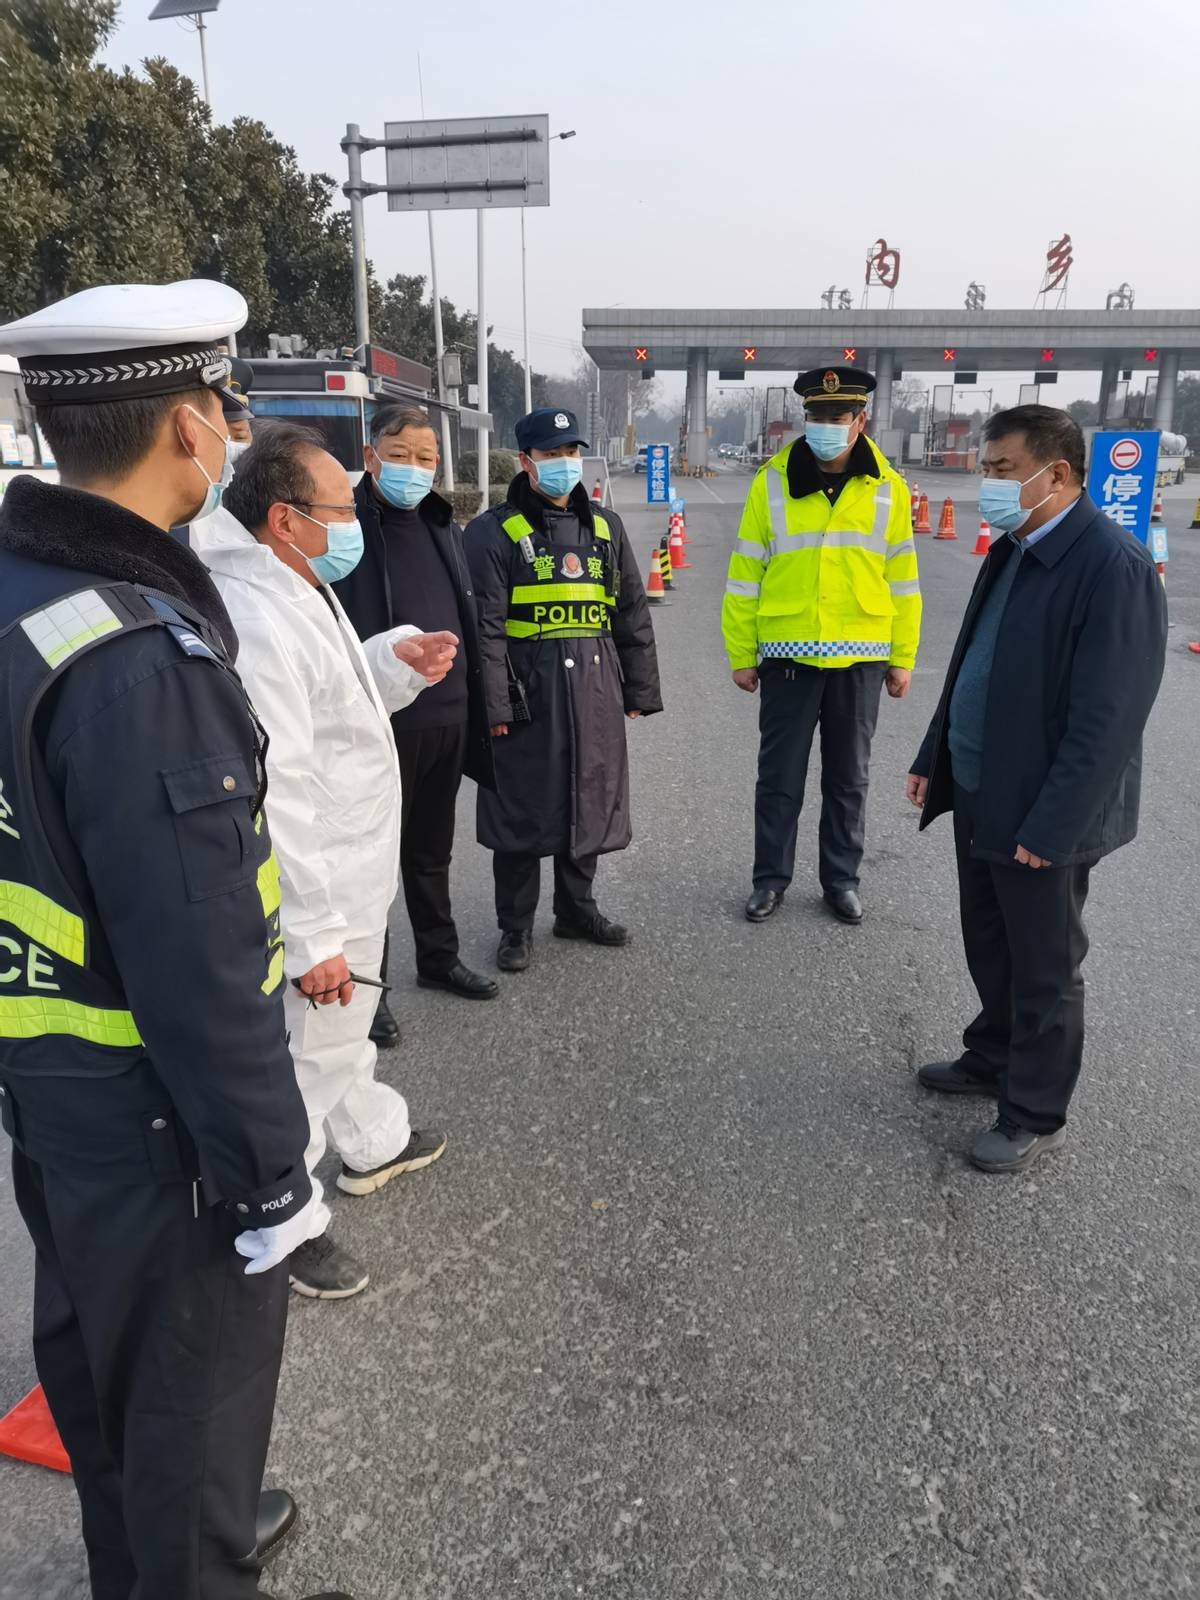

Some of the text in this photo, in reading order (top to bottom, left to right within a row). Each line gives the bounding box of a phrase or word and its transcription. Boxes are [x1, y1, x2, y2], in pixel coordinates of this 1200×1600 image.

[865, 233, 1074, 294] 内 乡
[533, 603, 608, 625] POLICE
[260, 1190, 295, 1214] POLICE
